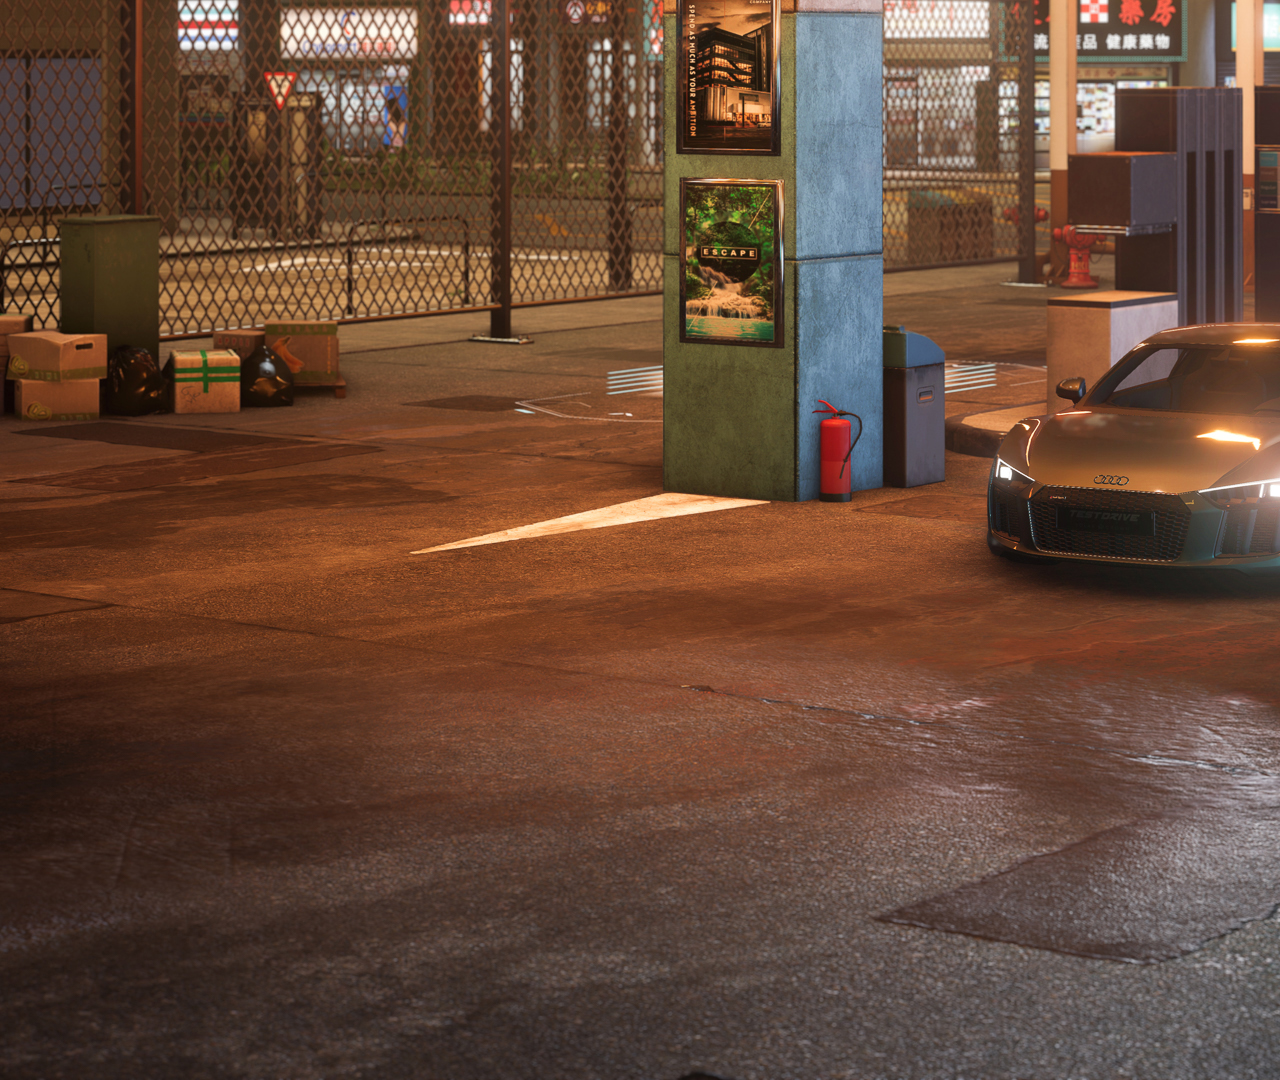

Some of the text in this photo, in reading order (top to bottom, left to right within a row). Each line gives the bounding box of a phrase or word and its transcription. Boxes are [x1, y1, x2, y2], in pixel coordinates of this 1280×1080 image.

[689, 31, 695, 40] AS
[689, 66, 696, 75] AS
[703, 248, 755, 257] ESCAPE
